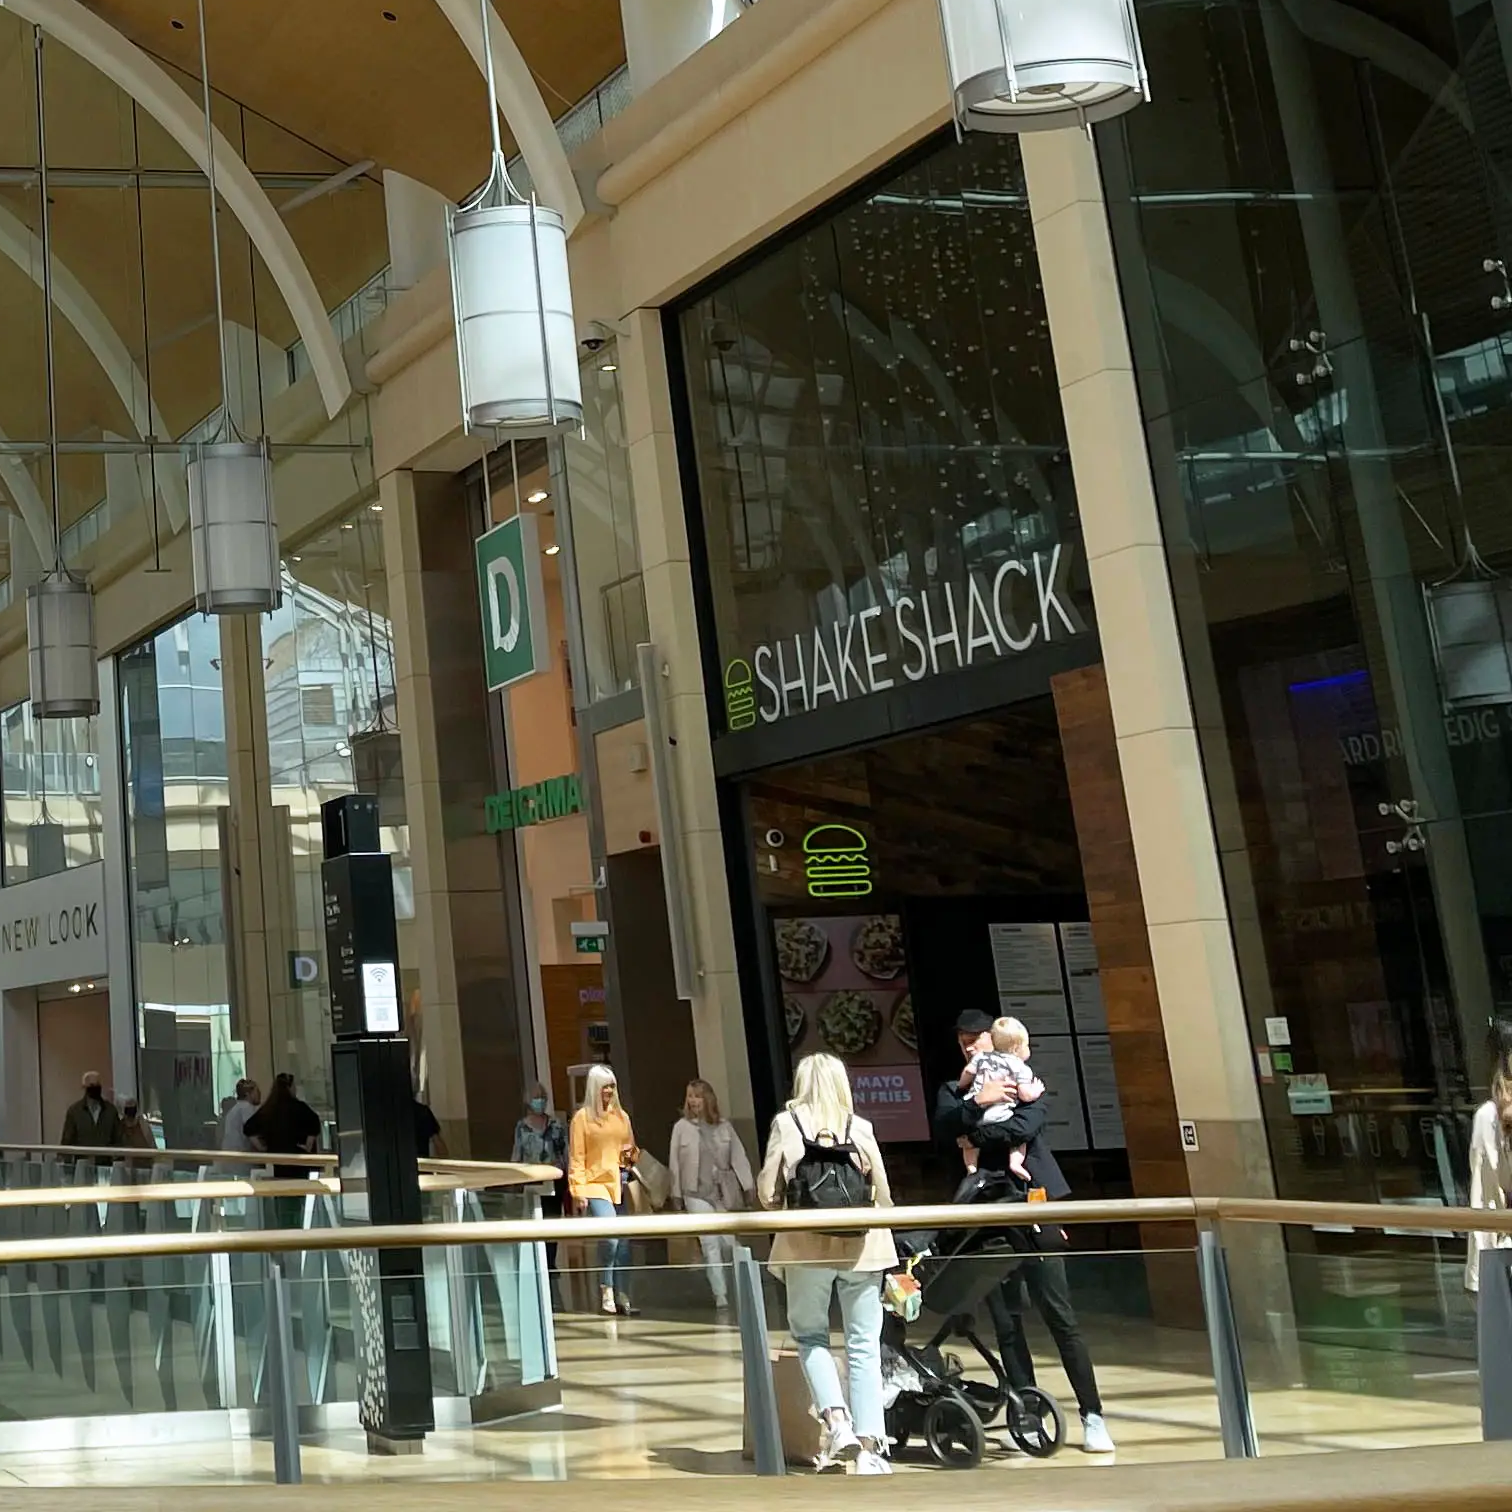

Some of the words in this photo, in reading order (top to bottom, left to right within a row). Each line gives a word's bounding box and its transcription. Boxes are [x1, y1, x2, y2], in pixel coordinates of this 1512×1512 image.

[487, 556, 520, 653] D
[754, 605, 894, 723] SHAKE
[896, 543, 1076, 681] SHACK
[484, 773, 586, 834] DEICHMA
[1, 916, 39, 954] NEW
[48, 902, 98, 945] LOOK
[857, 1075, 904, 1089] MAYO
[870, 1090, 912, 1103] FRIES
